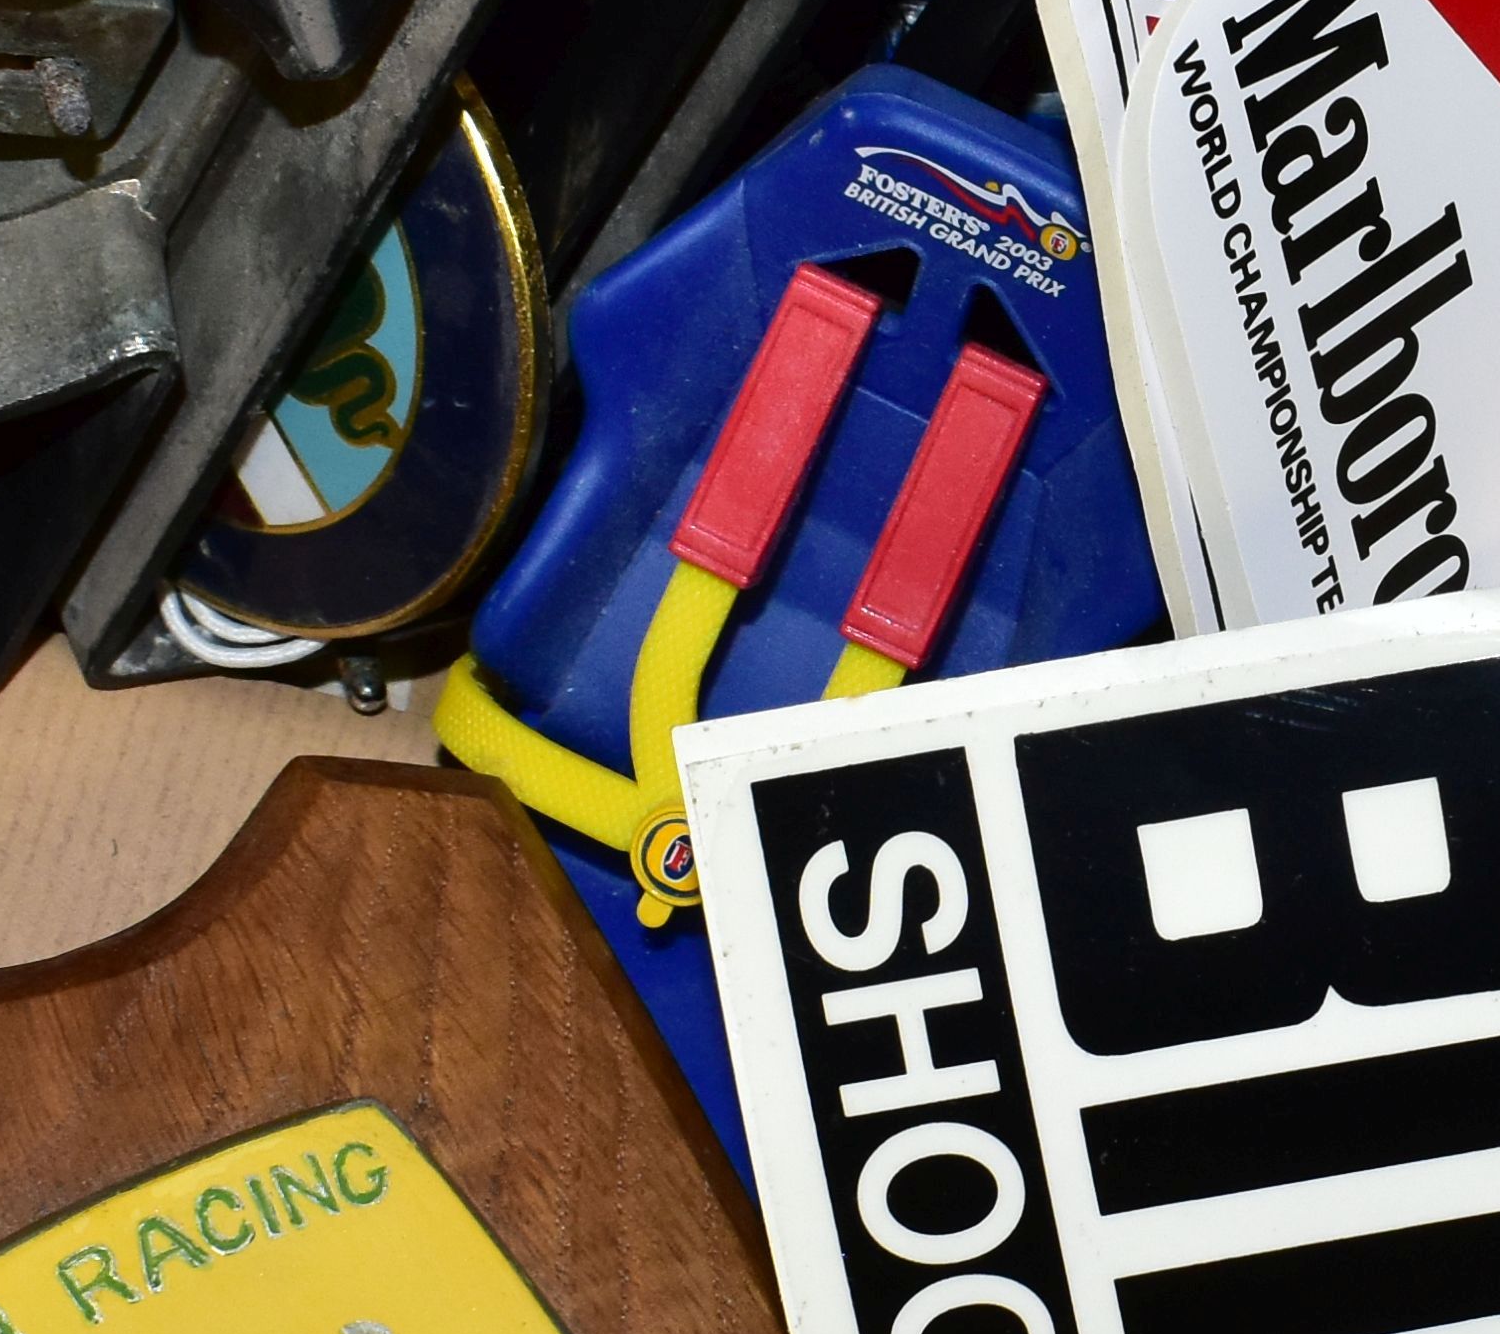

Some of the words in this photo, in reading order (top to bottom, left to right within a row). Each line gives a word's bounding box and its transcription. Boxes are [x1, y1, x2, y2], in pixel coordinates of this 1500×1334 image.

[843, 181, 926, 231] BRITISH
[928, 222, 1012, 272] GRAND
[1012, 264, 1067, 299] PRIX
[857, 163, 988, 236] FOSTER'S
[994, 235, 1054, 273] 2003
[1173, 39, 1244, 222] WORLD
[1227, 220, 1338, 557] CHAMPIONSHIP
[1309, 554, 1347, 615] TE
[57, 1139, 393, 1325] RACING
